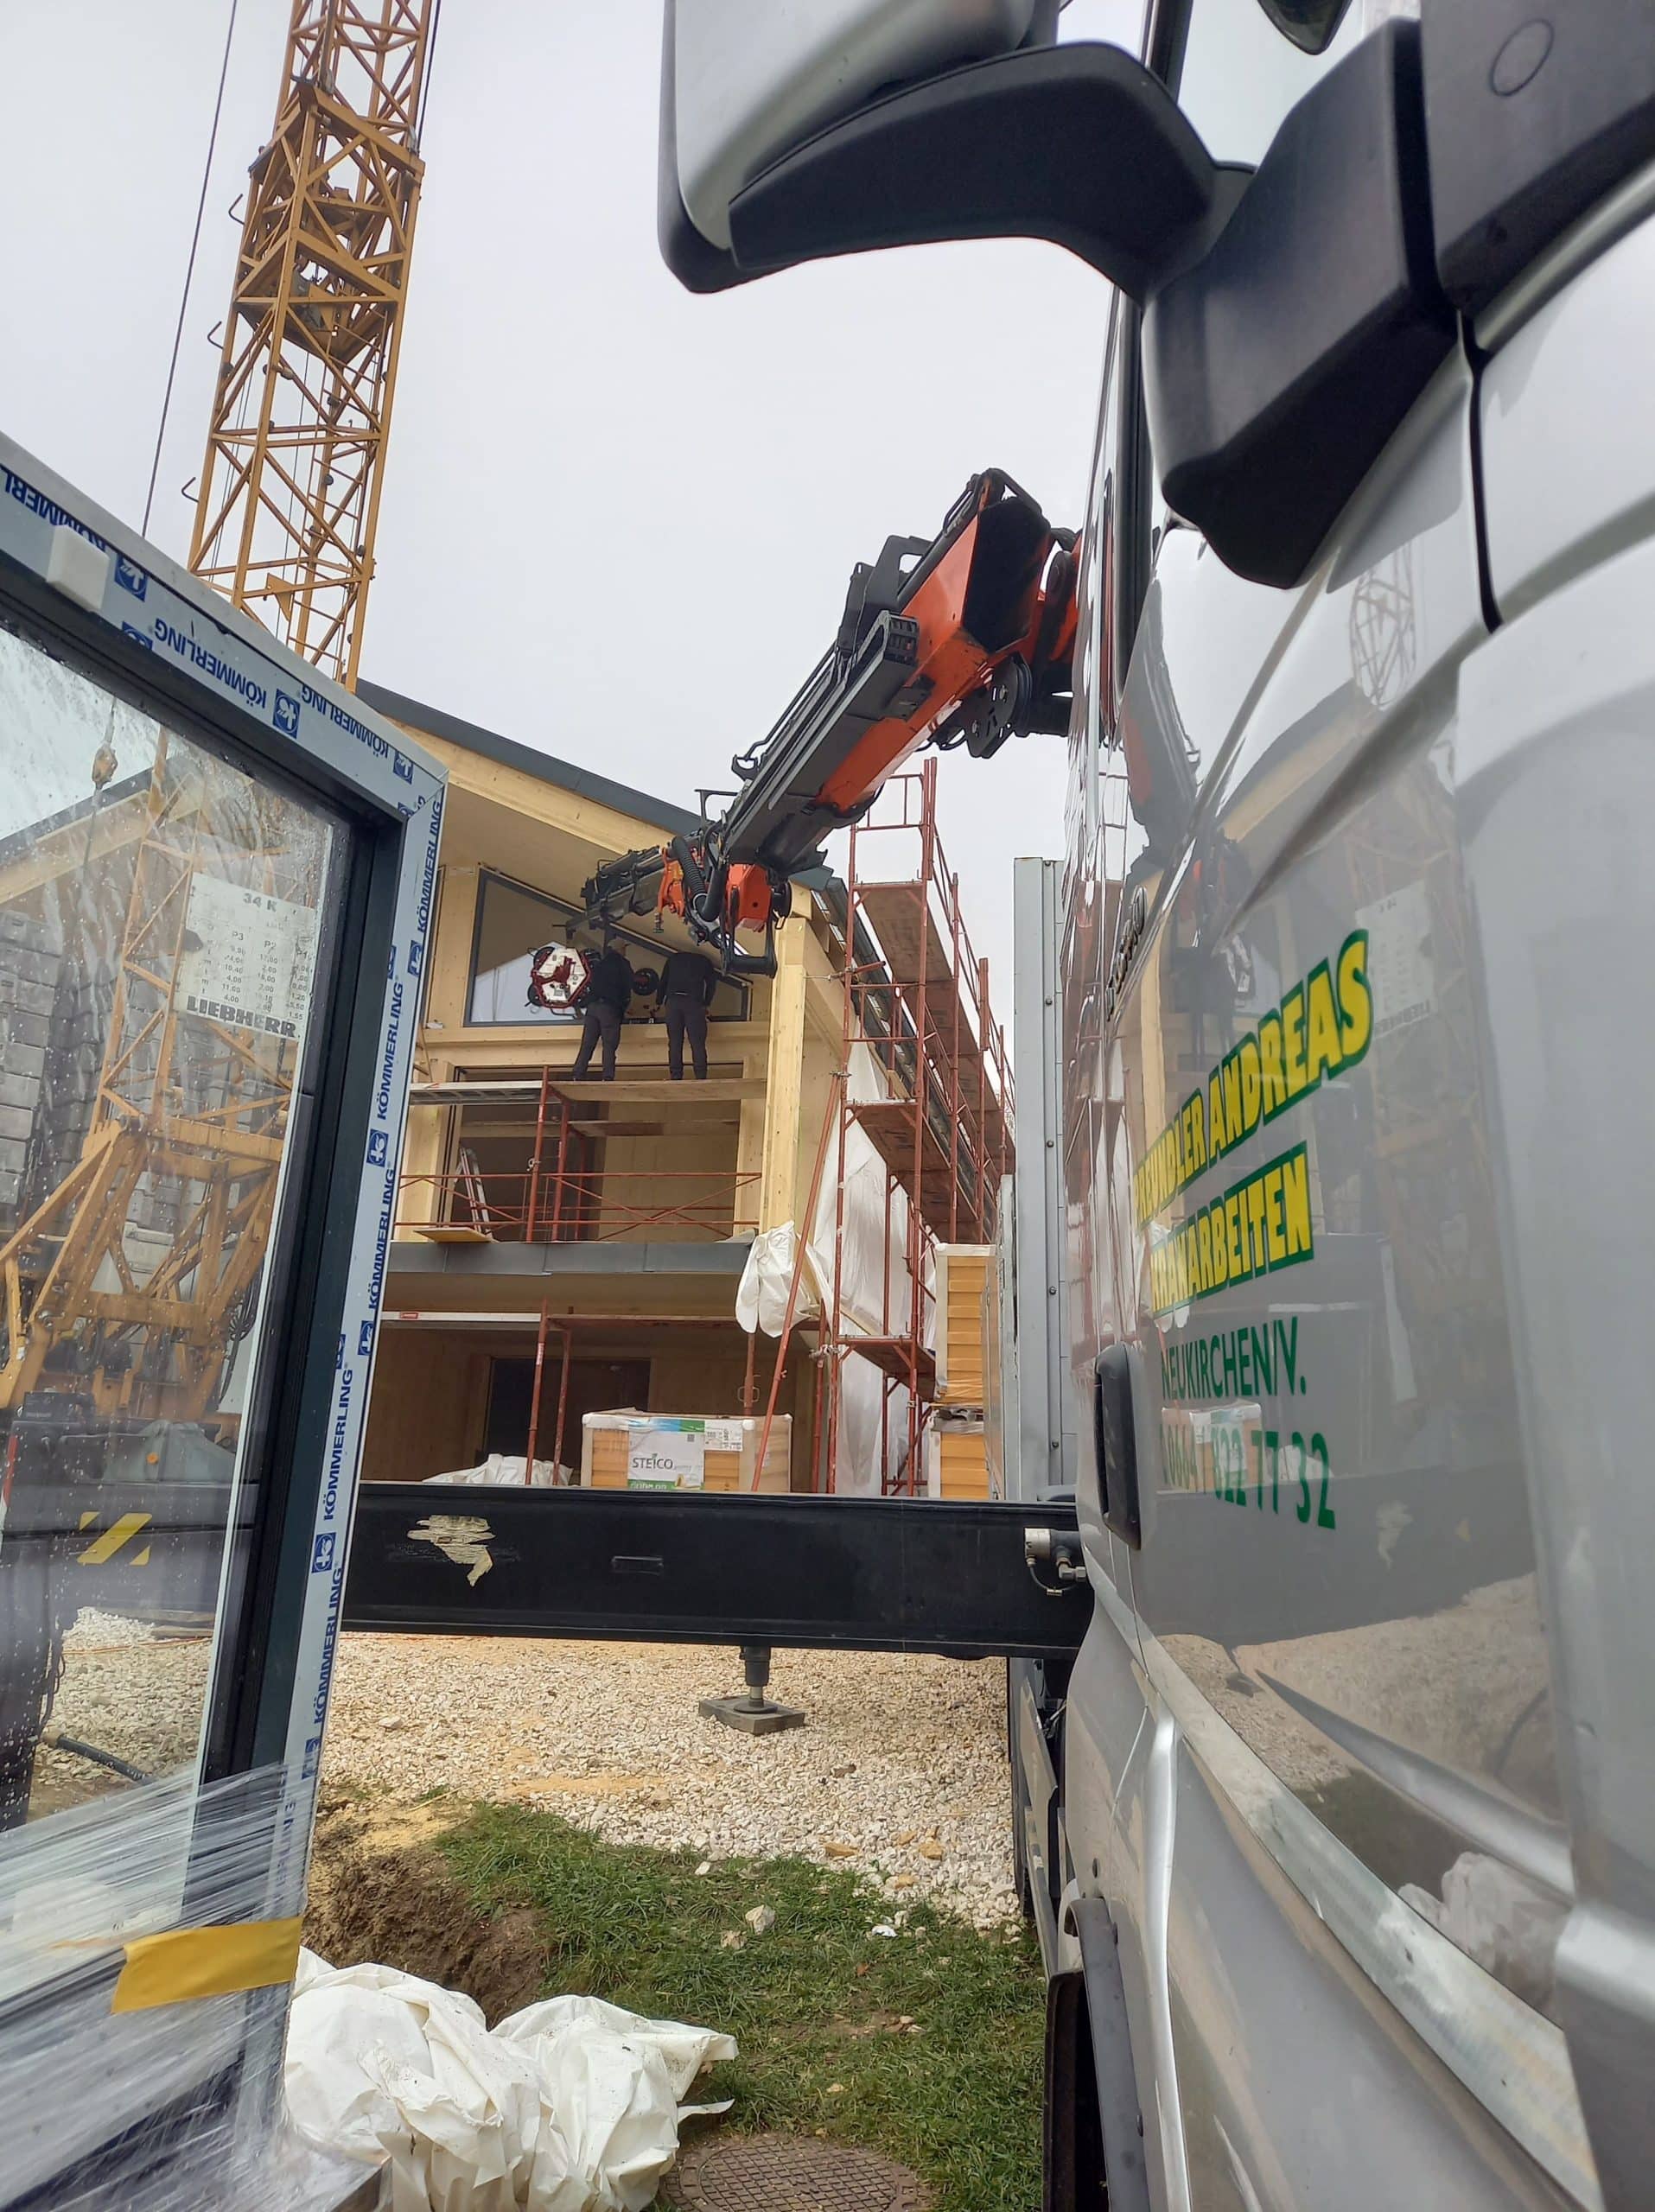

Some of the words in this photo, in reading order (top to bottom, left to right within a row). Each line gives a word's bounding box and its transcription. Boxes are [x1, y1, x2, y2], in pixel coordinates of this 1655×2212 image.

[154, 618, 267, 709] KÖMMERLING
[301, 684, 390, 759] KÖMMERLING
[243, 893, 261, 908] 34
[266, 899, 277, 912] K
[417, 800, 442, 933] KÖMMERLING
[187, 995, 296, 1038] LIEBHERR
[376, 981, 404, 1121] KÖMMERLING
[1207, 929, 1373, 1169] ANDREAS
[367, 1169, 395, 1311] KÖMMERLING
[1151, 1141, 1314, 1319] KRANARBEITEN
[322, 1369, 353, 1522] KÖMMERLING
[632, 1456, 673, 1470] STEICO
[313, 1567, 342, 1725] KÖMMERLING
